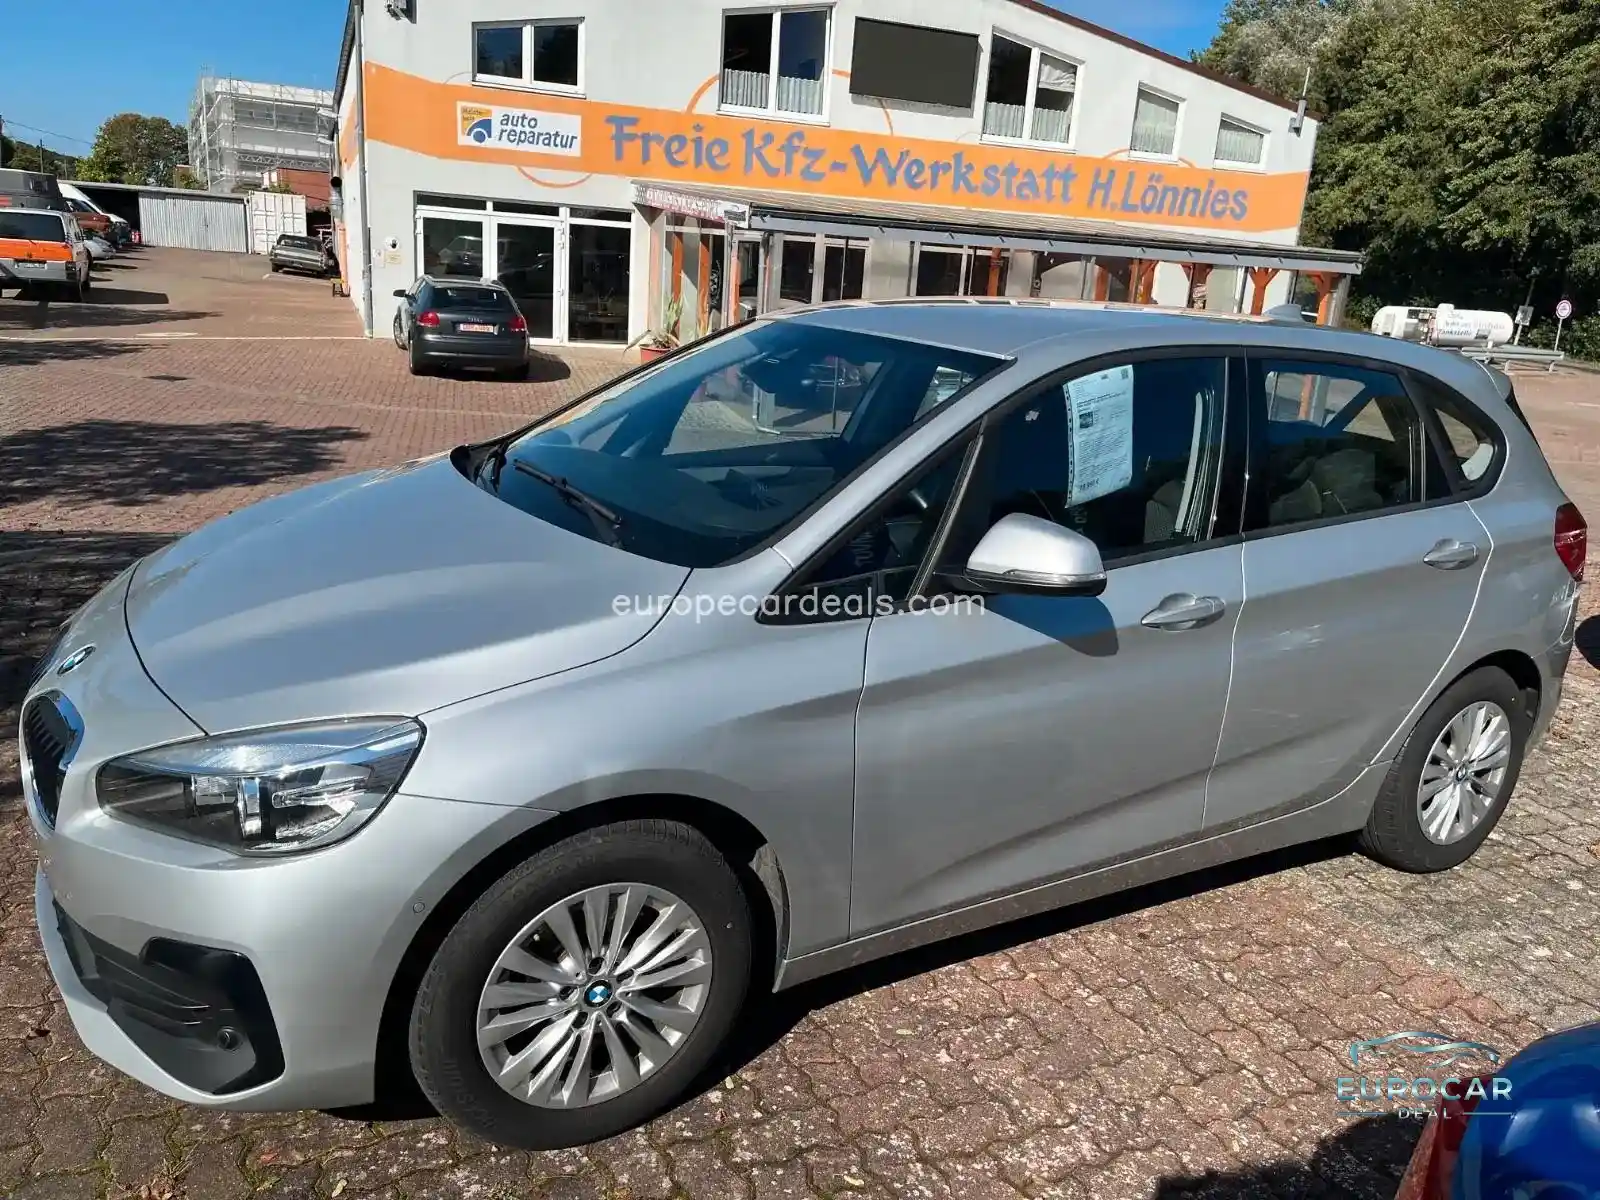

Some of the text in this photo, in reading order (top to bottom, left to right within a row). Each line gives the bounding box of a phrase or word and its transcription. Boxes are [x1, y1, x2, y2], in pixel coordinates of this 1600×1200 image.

[499, 112, 538, 130] auto
[498, 127, 578, 150] reparatur
[605, 115, 731, 171] Freie
[743, 126, 1079, 206] Kfz-Werkstatt
[1086, 166, 1248, 221] H.Lönnies
